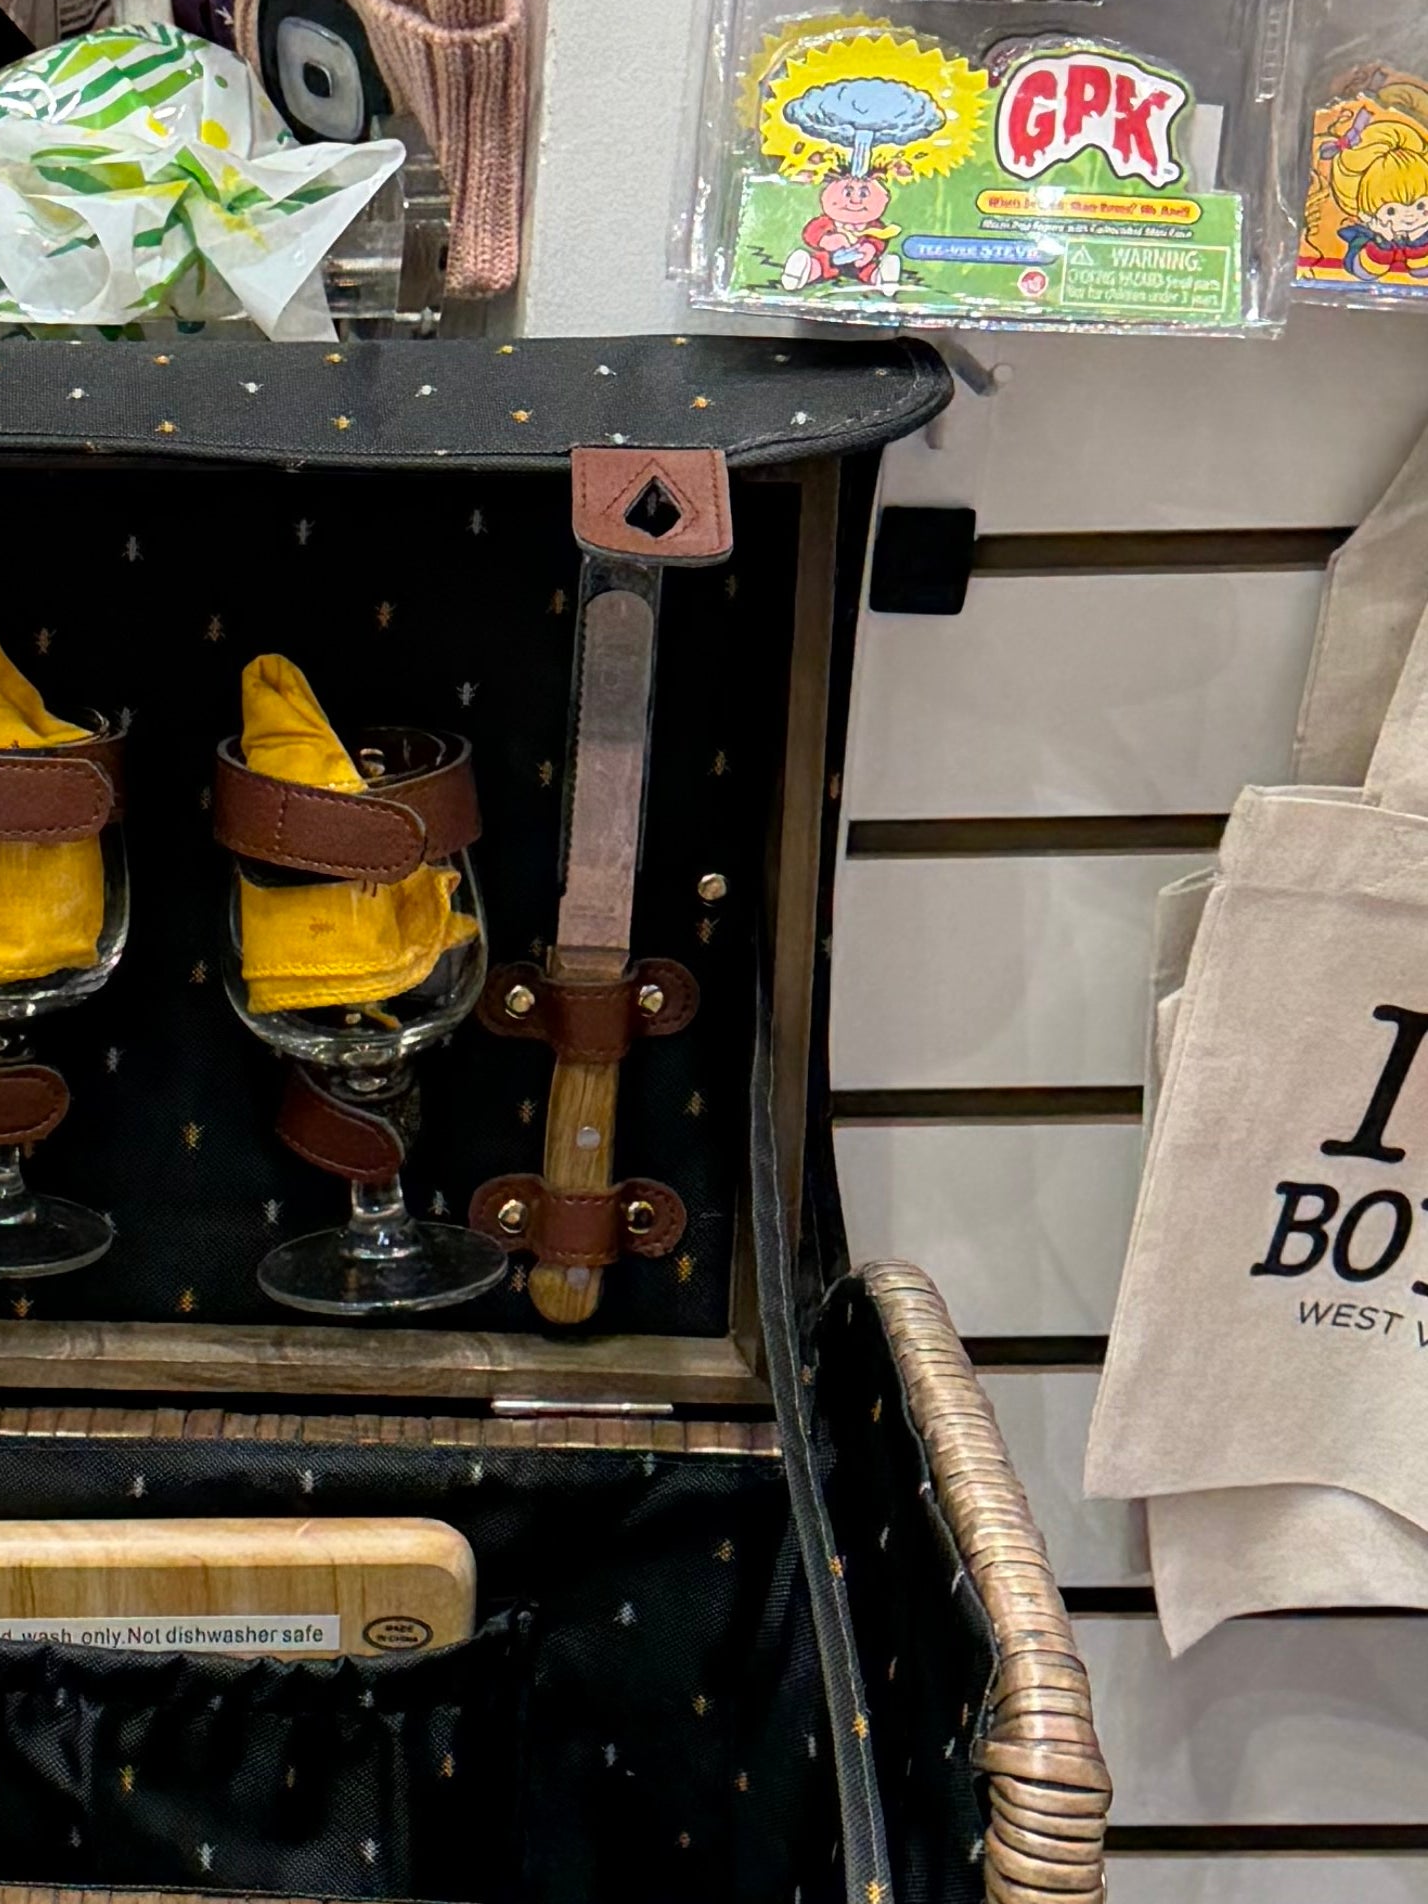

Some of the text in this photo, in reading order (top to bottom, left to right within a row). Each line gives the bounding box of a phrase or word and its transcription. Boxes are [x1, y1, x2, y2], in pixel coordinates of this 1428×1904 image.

[1008, 64, 1171, 178] GPK
[1112, 248, 1202, 271] WARNING:
[1320, 1003, 1428, 1164] I
[1250, 1179, 1428, 1296] BO
[1298, 1301, 1403, 1335] WEST
[22, 1628, 72, 1645] wash
[165, 1625, 278, 1645] dishwasher
[282, 1625, 324, 1644] safe
